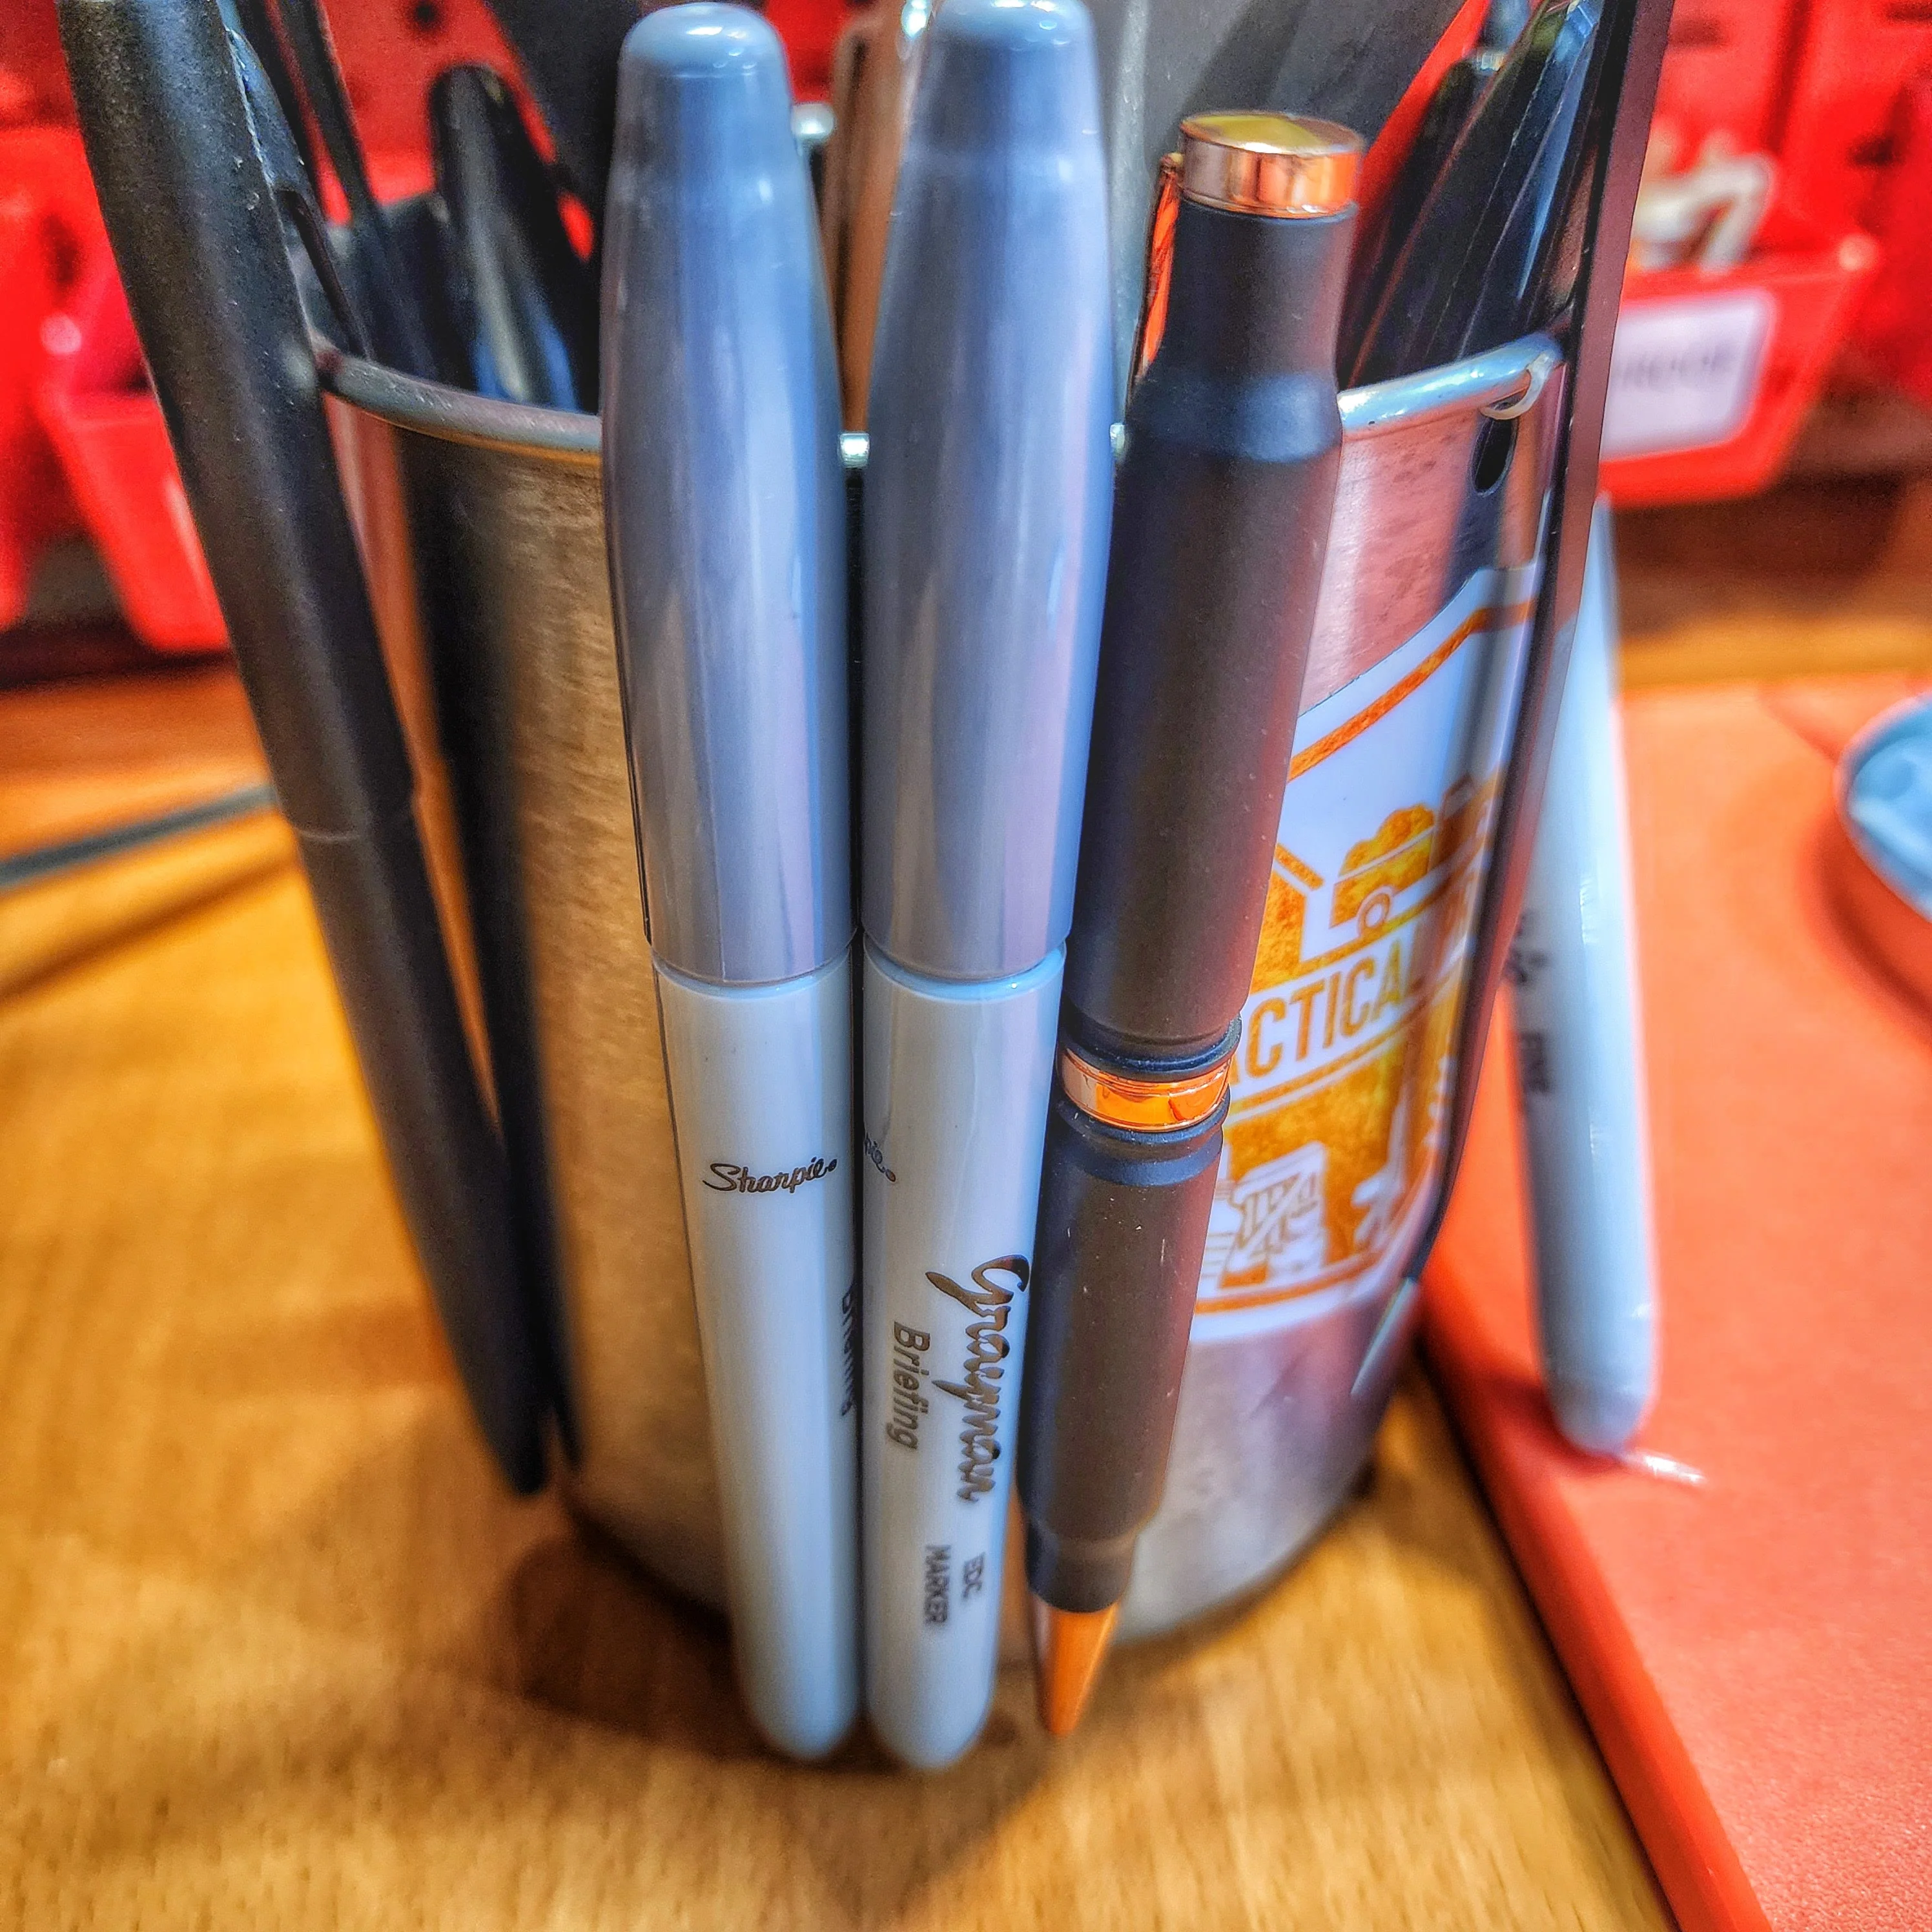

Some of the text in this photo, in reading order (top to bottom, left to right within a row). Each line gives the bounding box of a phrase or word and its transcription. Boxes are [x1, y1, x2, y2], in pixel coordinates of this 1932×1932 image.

[703, 1156, 838, 1193] Sharpie
[886, 1321, 930, 1451] Briefing
[925, 1254, 1030, 1502] Grayman
[925, 1545, 952, 1626] MARKER
[963, 1552, 985, 1601] EDC
